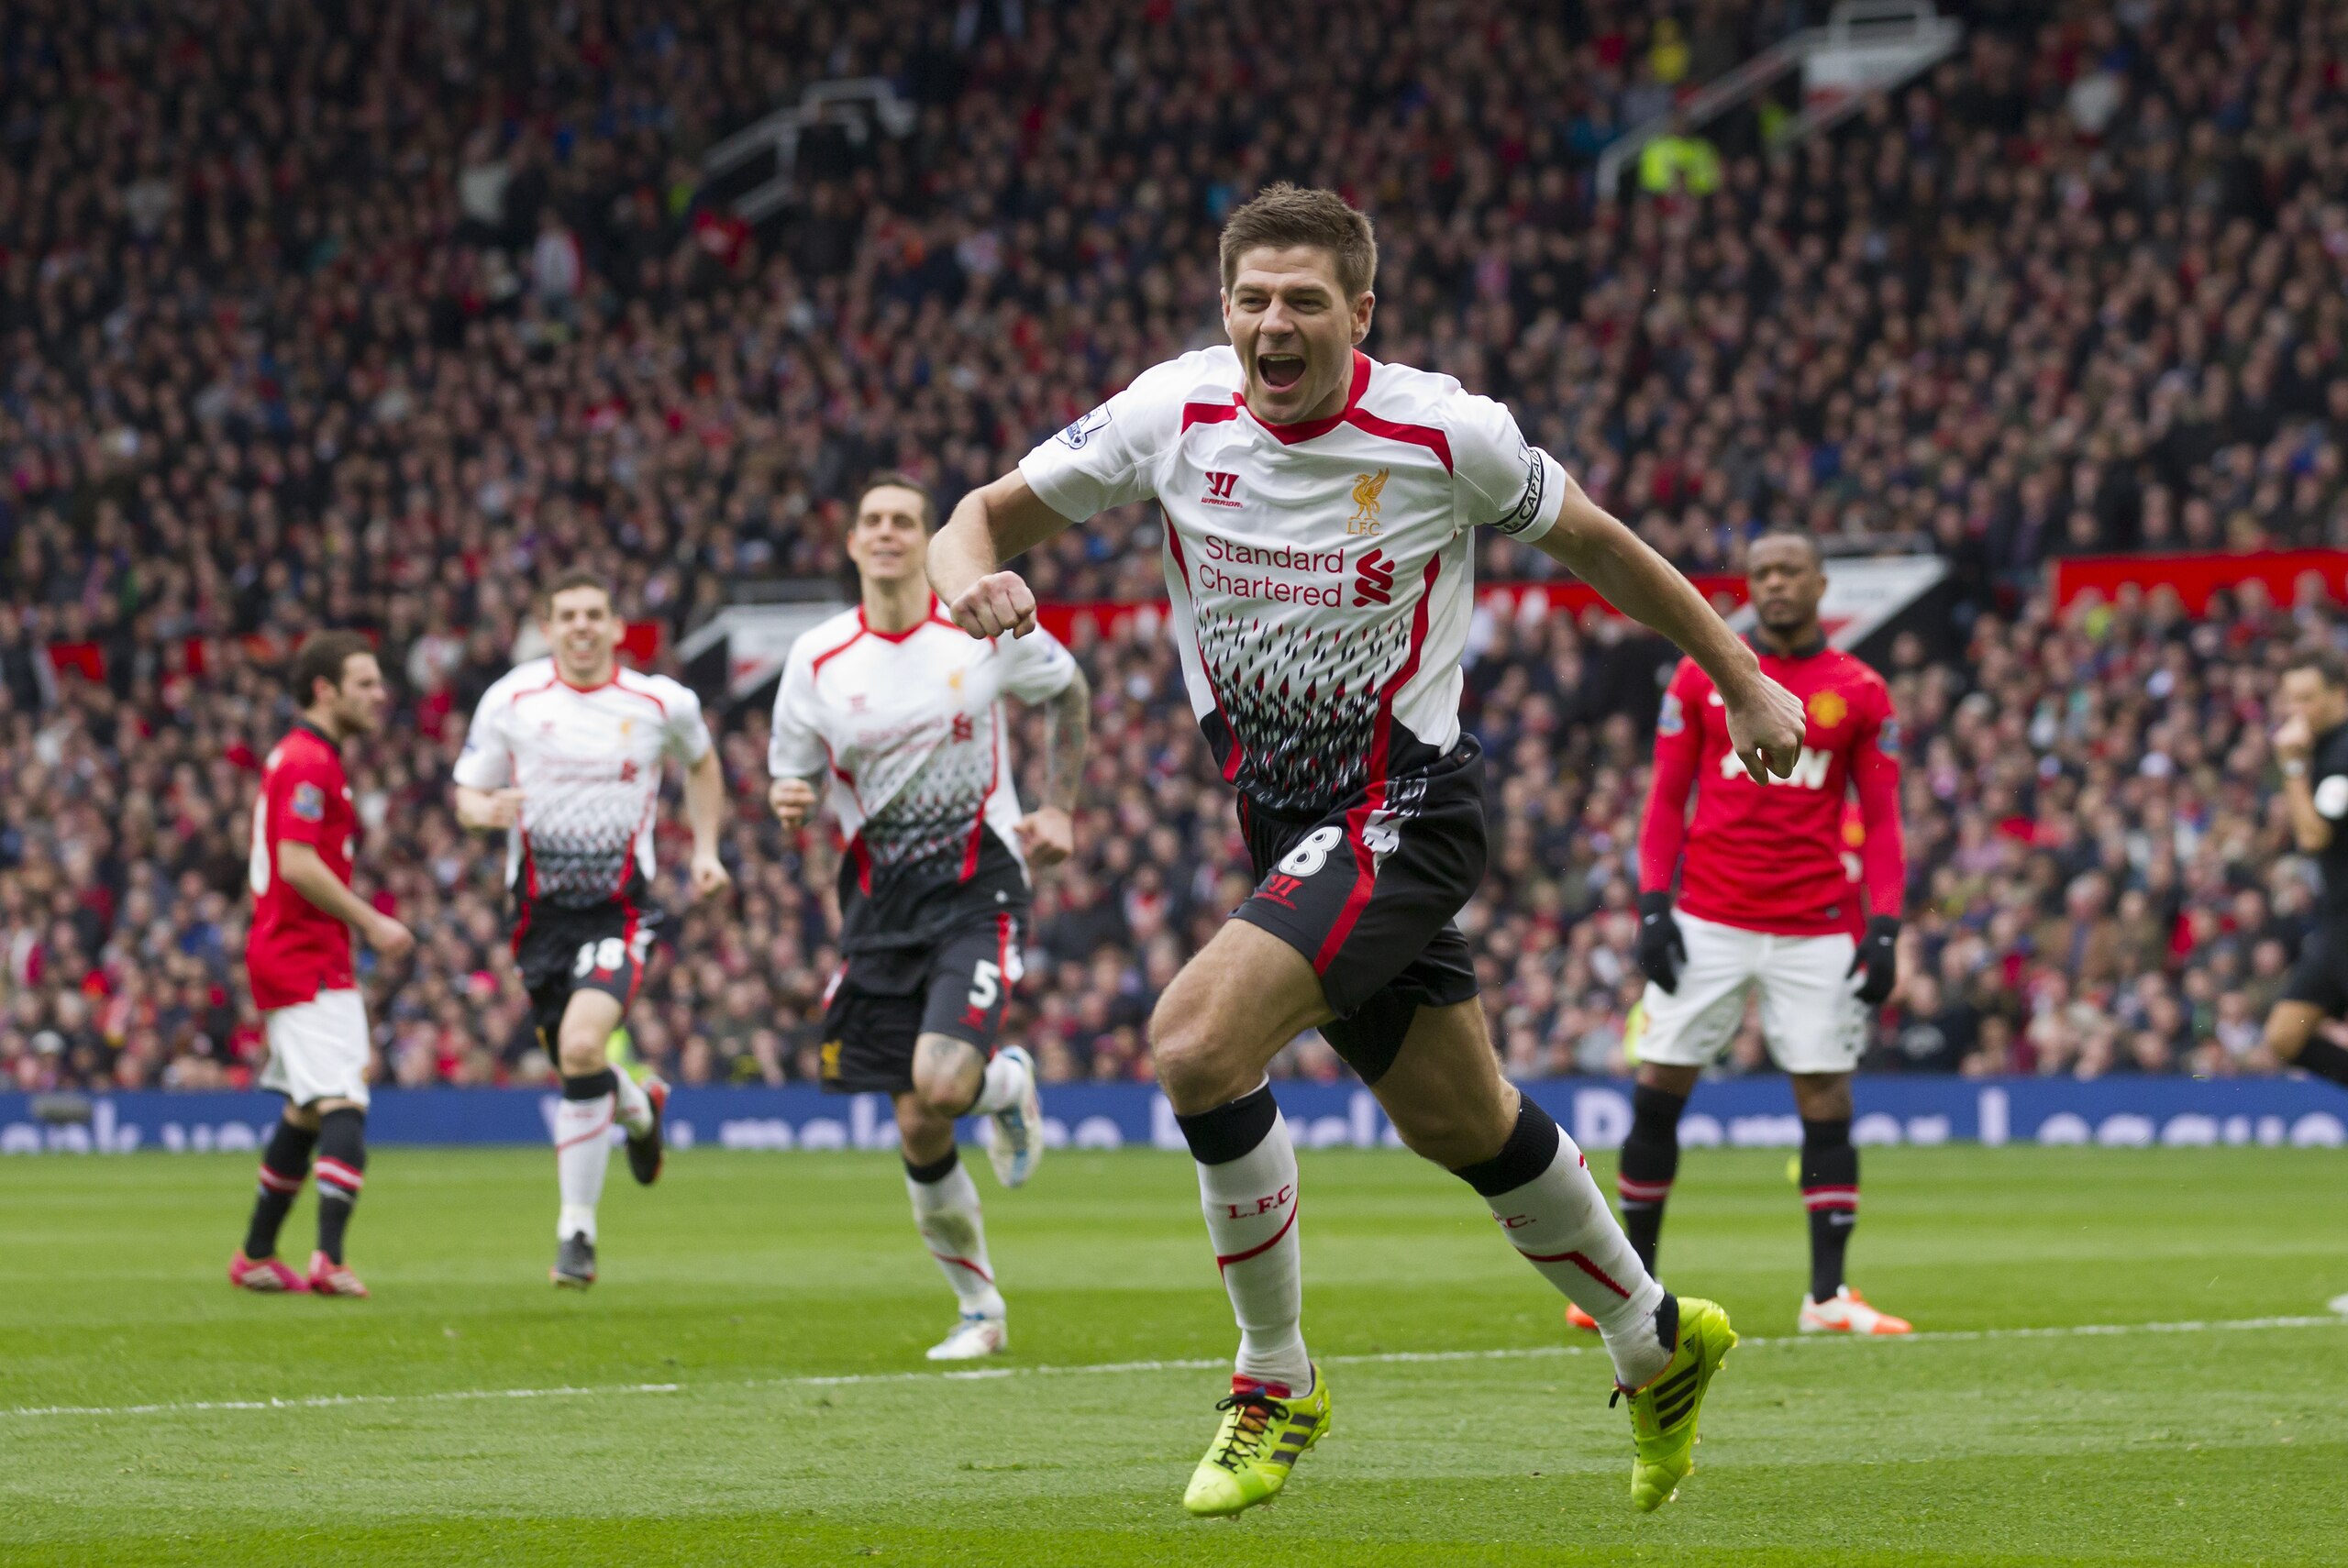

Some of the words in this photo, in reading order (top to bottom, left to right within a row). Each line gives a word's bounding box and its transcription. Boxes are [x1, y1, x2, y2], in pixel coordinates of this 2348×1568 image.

[1205, 535, 1344, 573] Standard
[1200, 564, 1342, 608] Chartered
[1278, 825, 1343, 878] 8
[969, 959, 1001, 1009] 5
